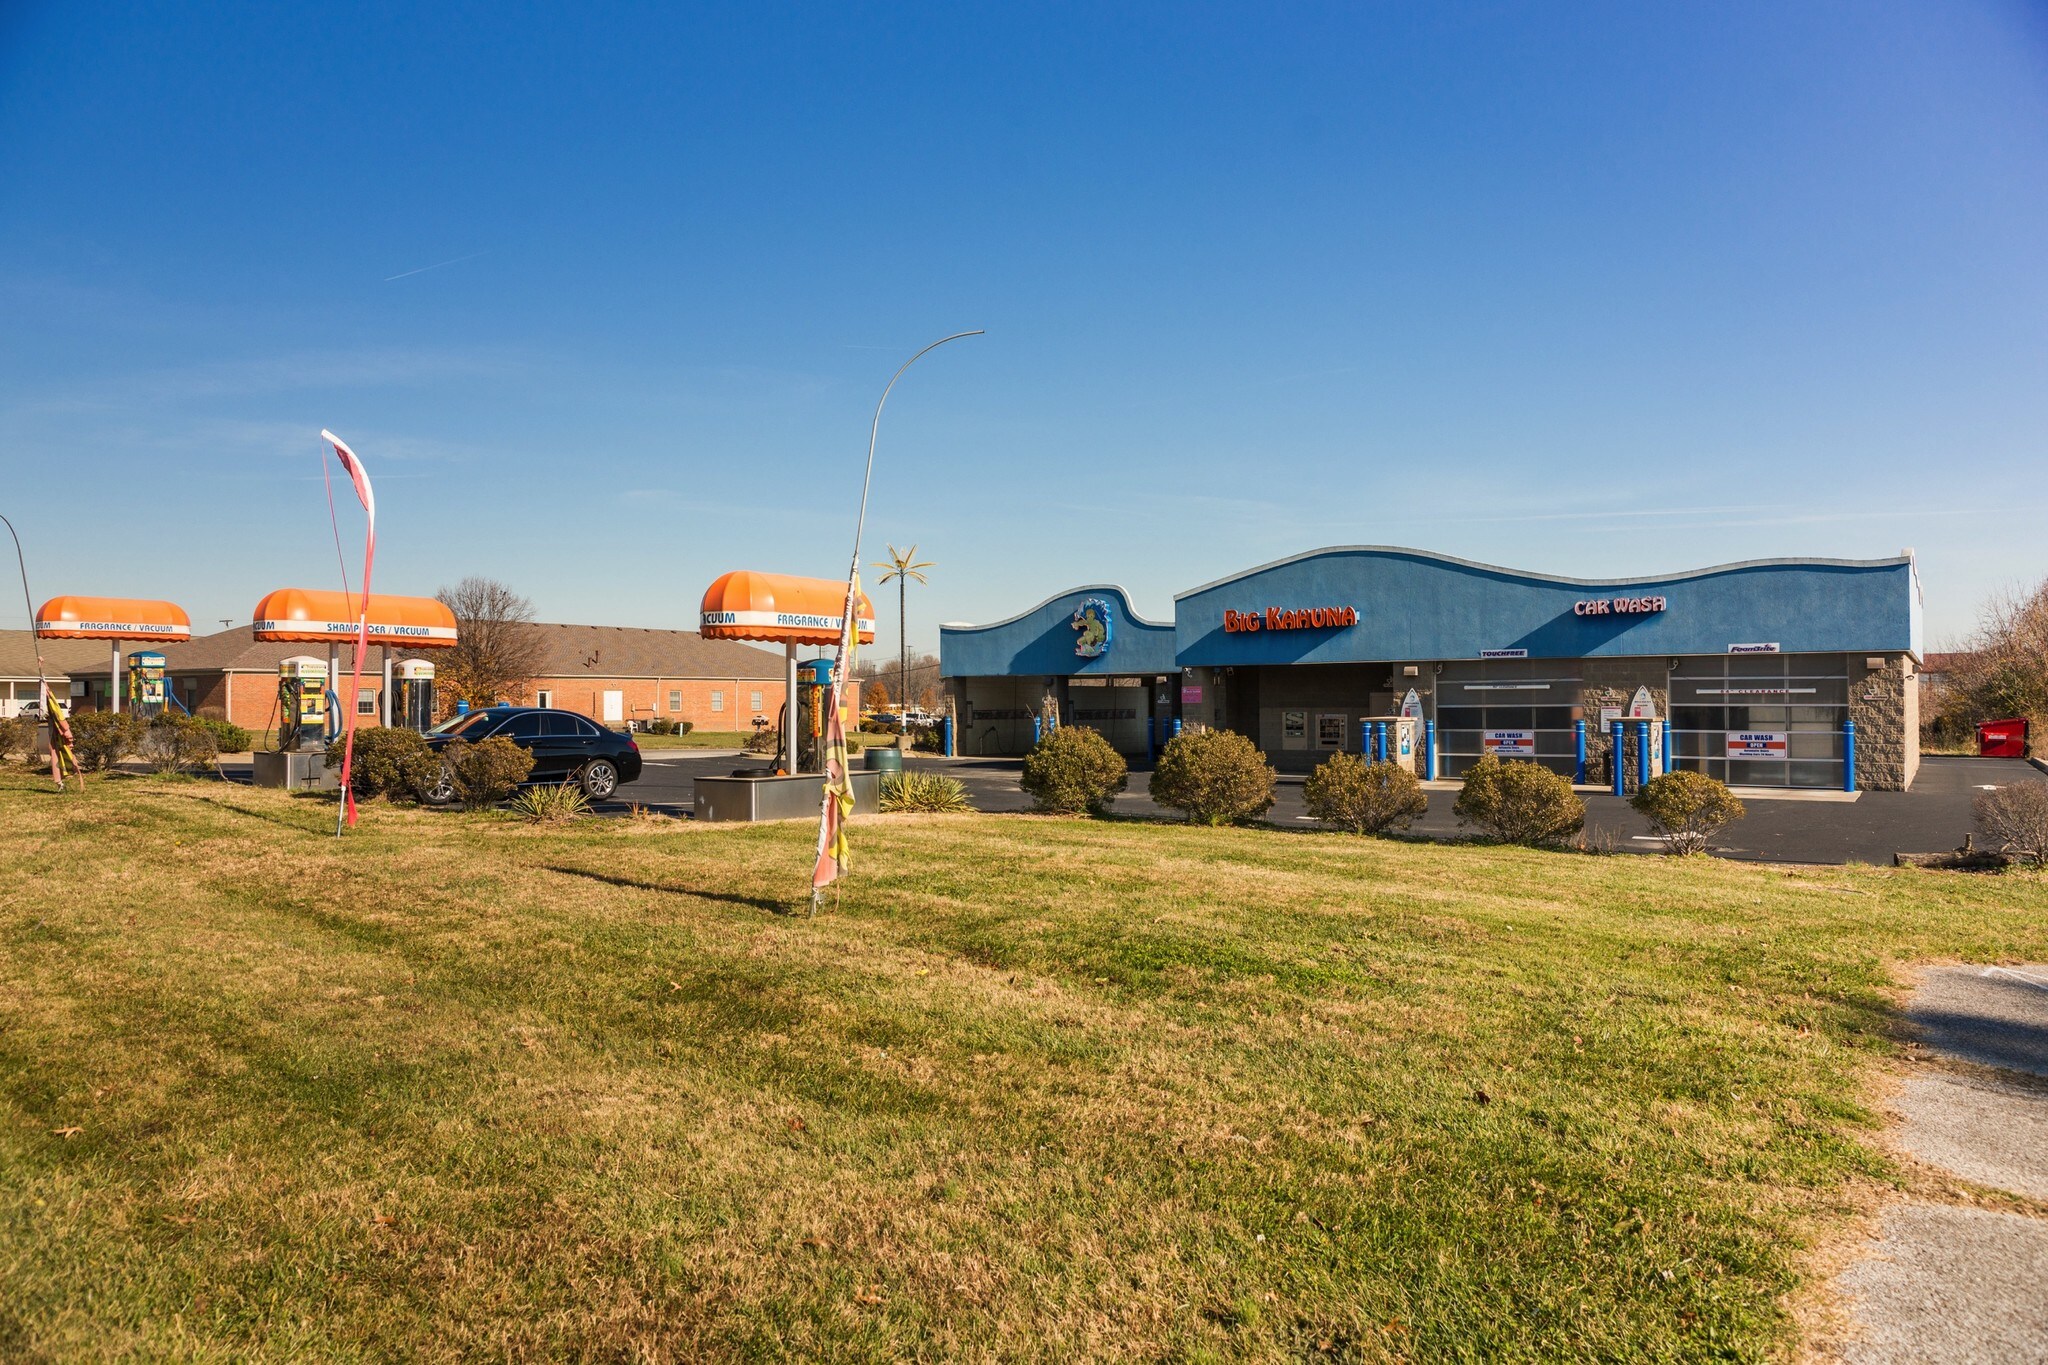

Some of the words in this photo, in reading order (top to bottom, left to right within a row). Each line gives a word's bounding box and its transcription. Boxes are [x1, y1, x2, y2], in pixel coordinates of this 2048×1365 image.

[1574, 600, 1609, 616] CAR
[1613, 595, 1667, 613] WASH
[777, 613, 828, 627] FRAGRANCE
[1224, 609, 1260, 632] BIG
[1266, 605, 1357, 630] KAHUNA
[80, 622, 131, 631] FRAGRANCE
[140, 624, 173, 632] VACUUM
[327, 623, 386, 634] SHAMPOER
[394, 626, 430, 636] VACUUM
